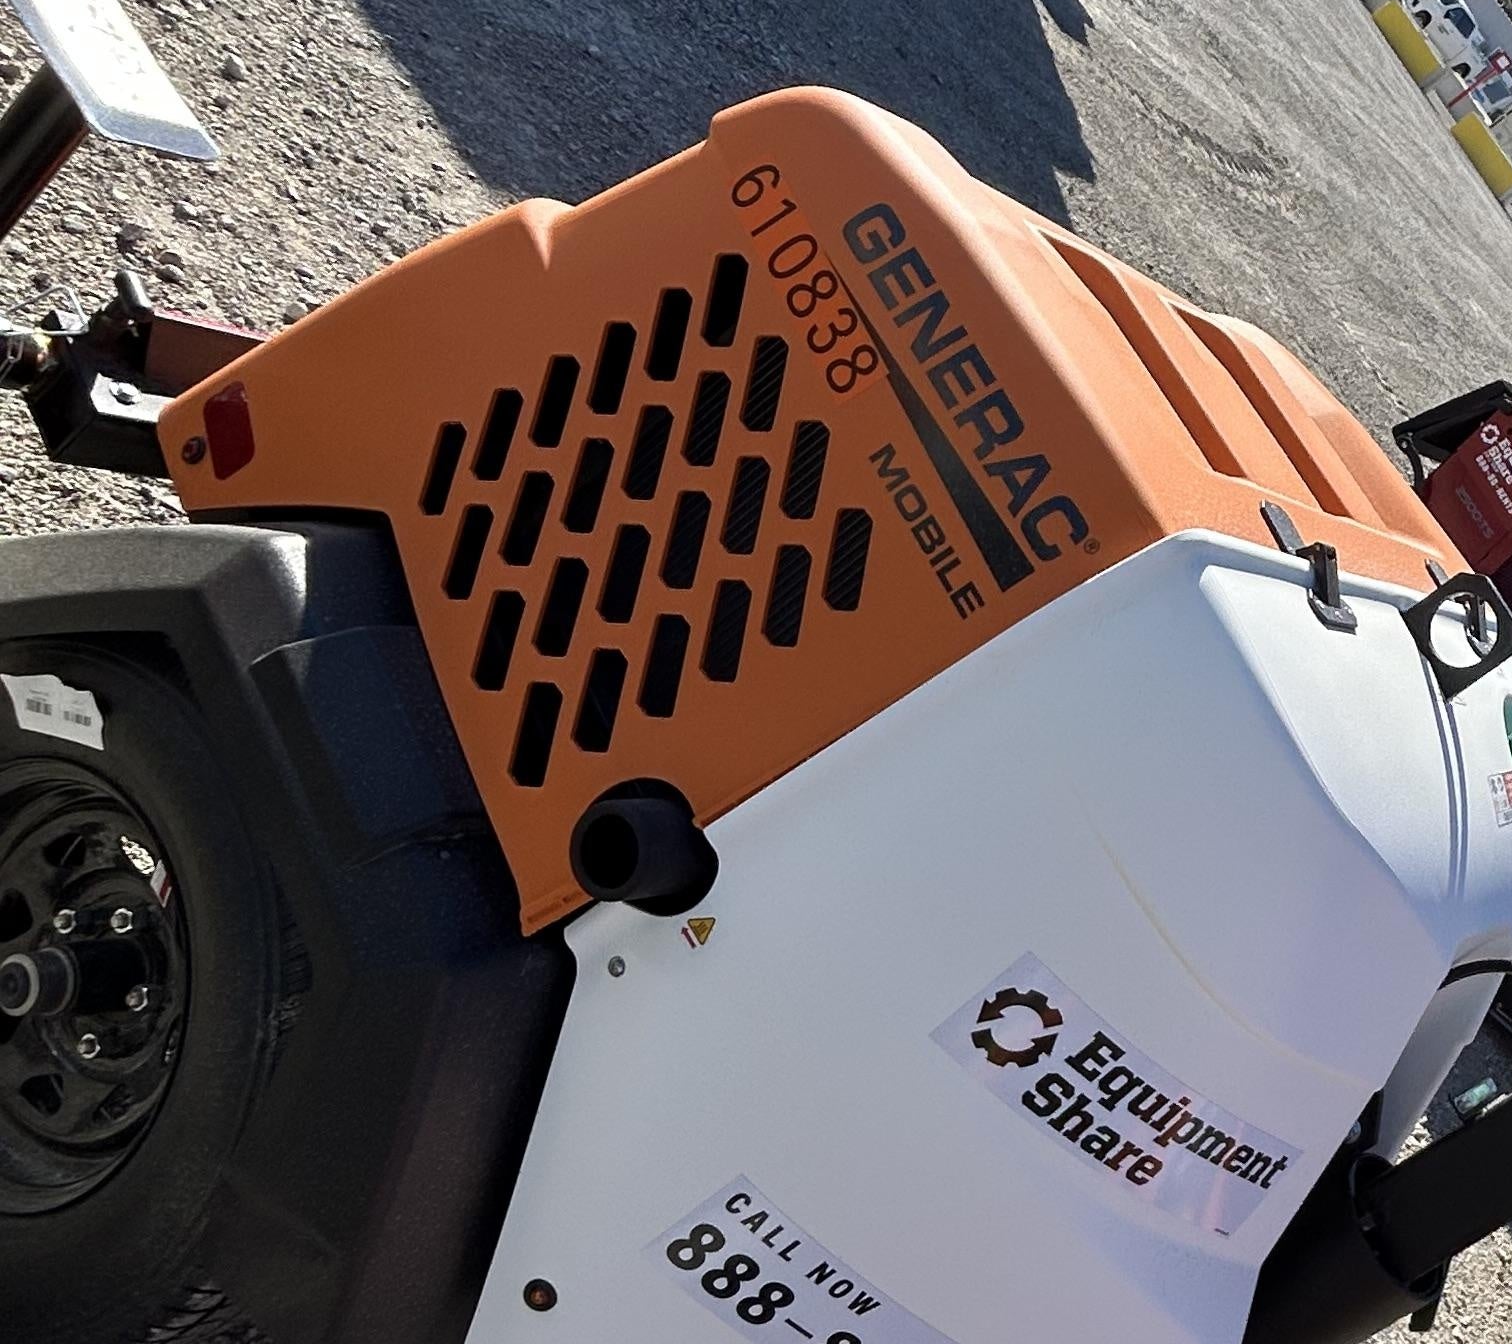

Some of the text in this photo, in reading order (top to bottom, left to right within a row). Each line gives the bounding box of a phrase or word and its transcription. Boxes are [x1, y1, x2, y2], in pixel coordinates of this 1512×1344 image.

[731, 164, 878, 394] 610838
[870, 443, 985, 619] MOBILE
[1022, 1074, 1163, 1187] Share
[1066, 1031, 1288, 1189] Equipment
[725, 1193, 880, 1316] CALL NOW
